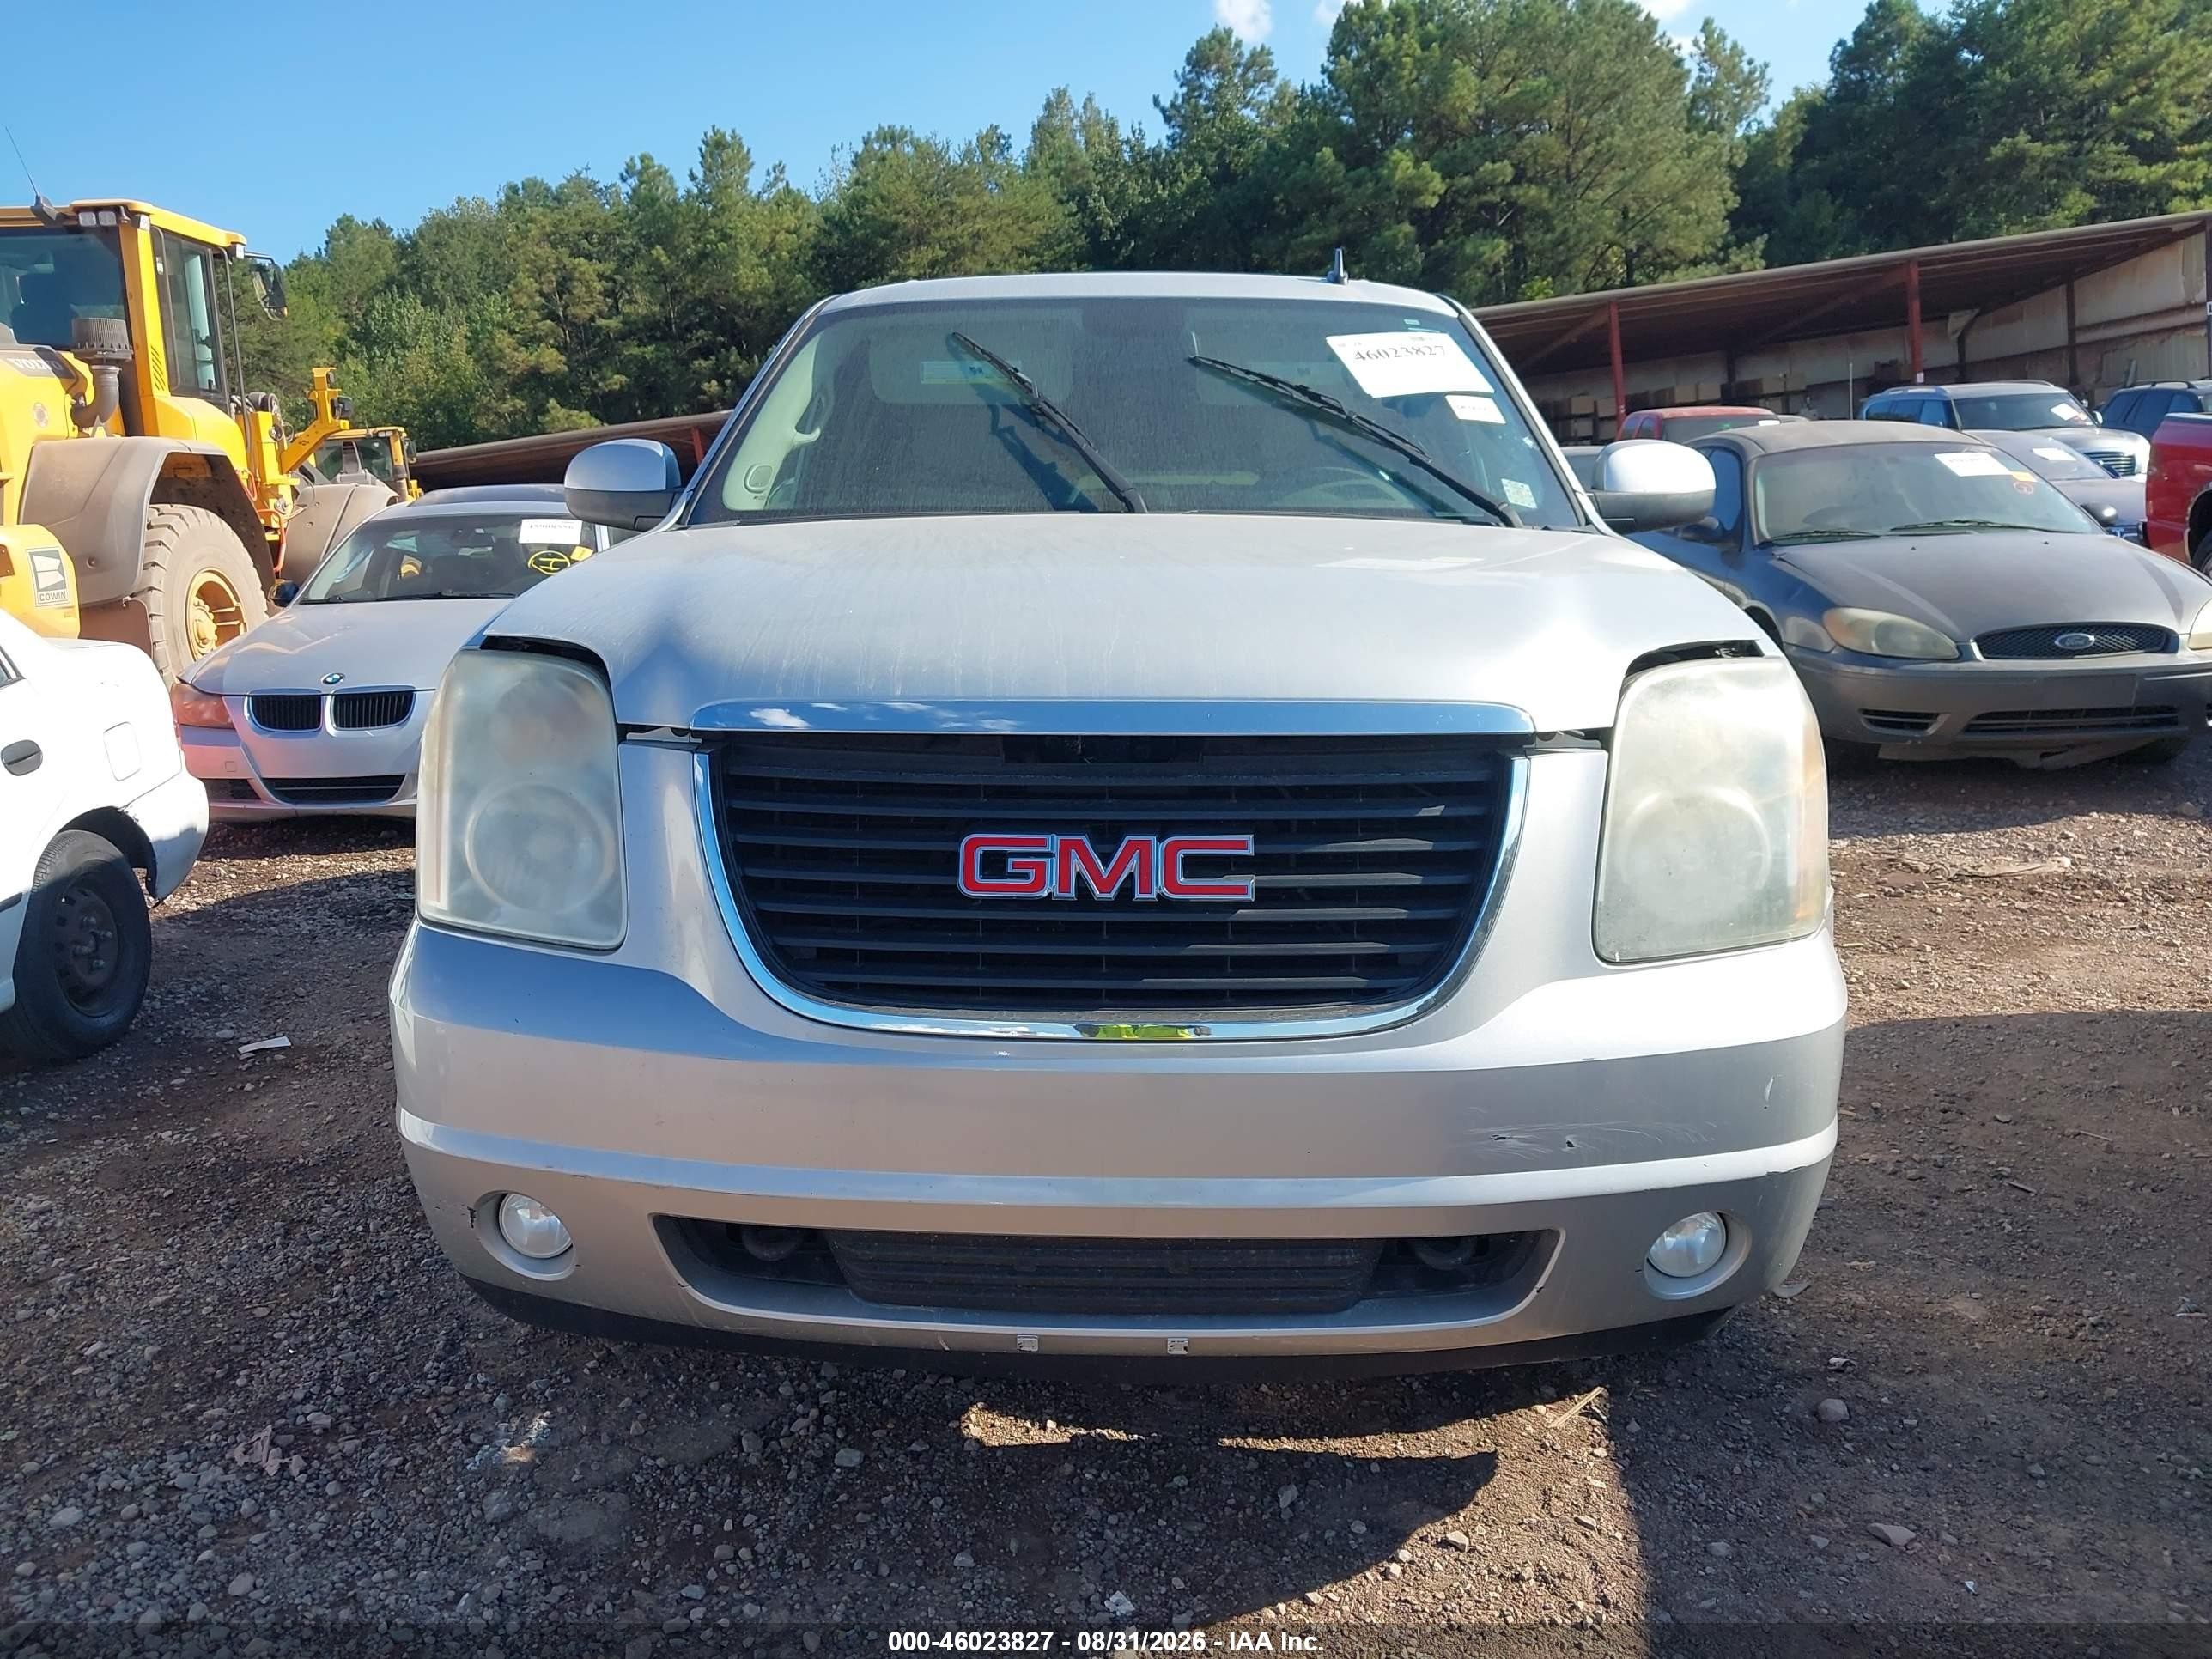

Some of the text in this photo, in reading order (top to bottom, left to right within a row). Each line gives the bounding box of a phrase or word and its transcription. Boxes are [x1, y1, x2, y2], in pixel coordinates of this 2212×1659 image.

[1354, 344, 1446, 361] 46023827
[9, 357, 64, 371] VOLVO
[40, 591, 66, 601] COWIN
[957, 833, 1255, 902] GMC
